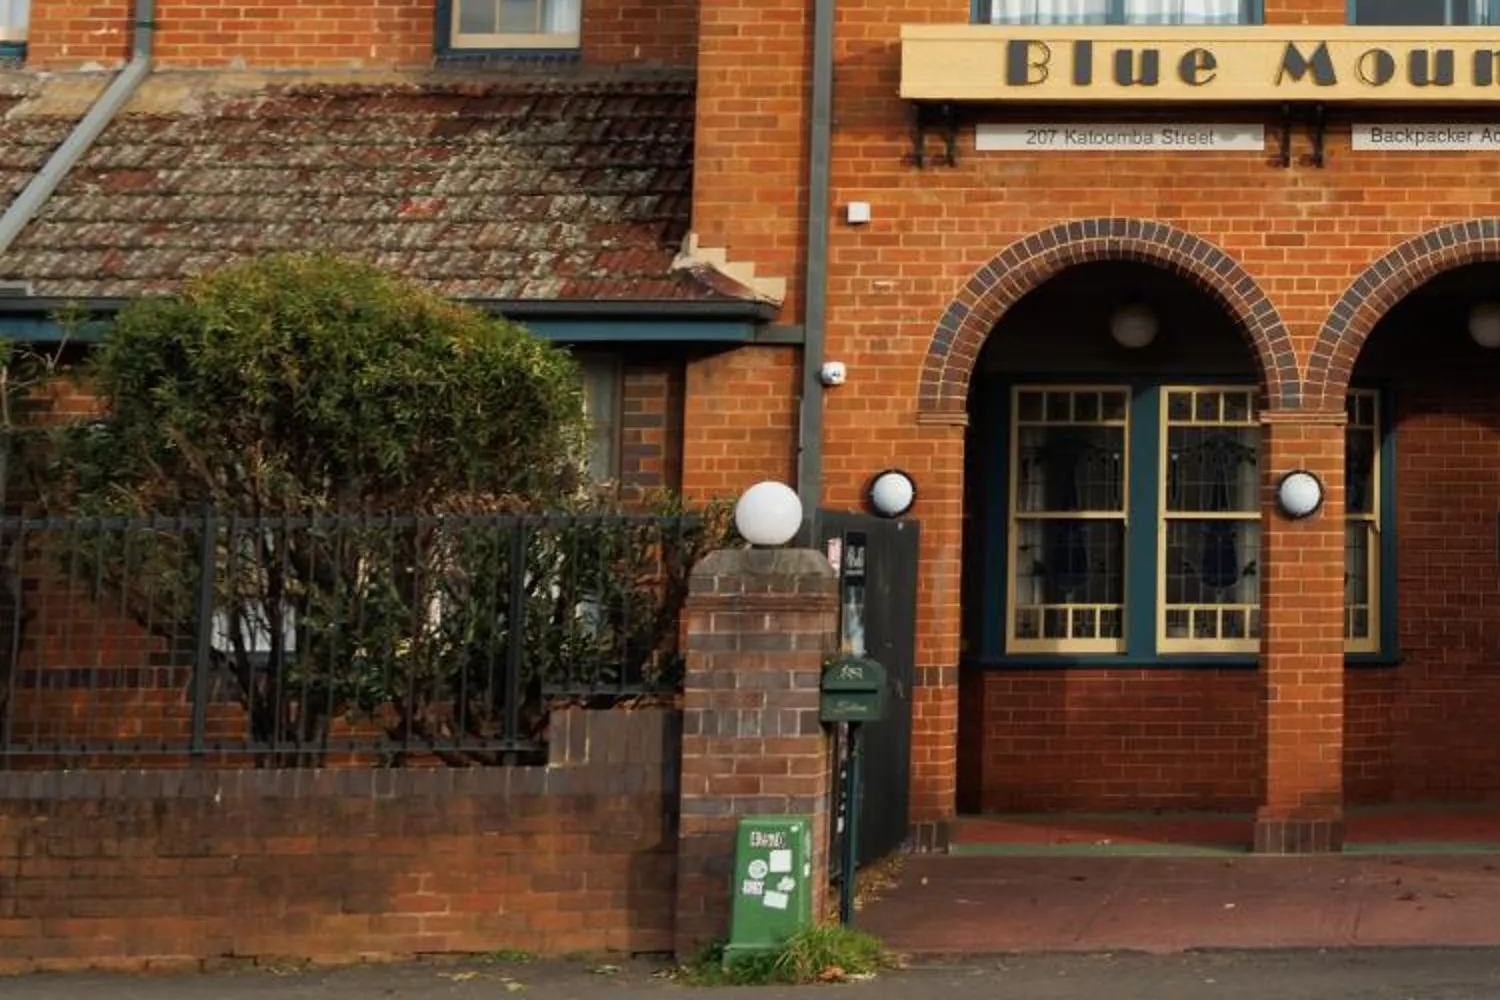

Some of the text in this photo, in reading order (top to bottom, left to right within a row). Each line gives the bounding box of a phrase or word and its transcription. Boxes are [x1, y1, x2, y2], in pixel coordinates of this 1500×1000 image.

[1005, 39, 1217, 87] Blue
[1026, 129, 1214, 145] 207 Katoomba Street
[1370, 127, 1473, 146] Backpacker
